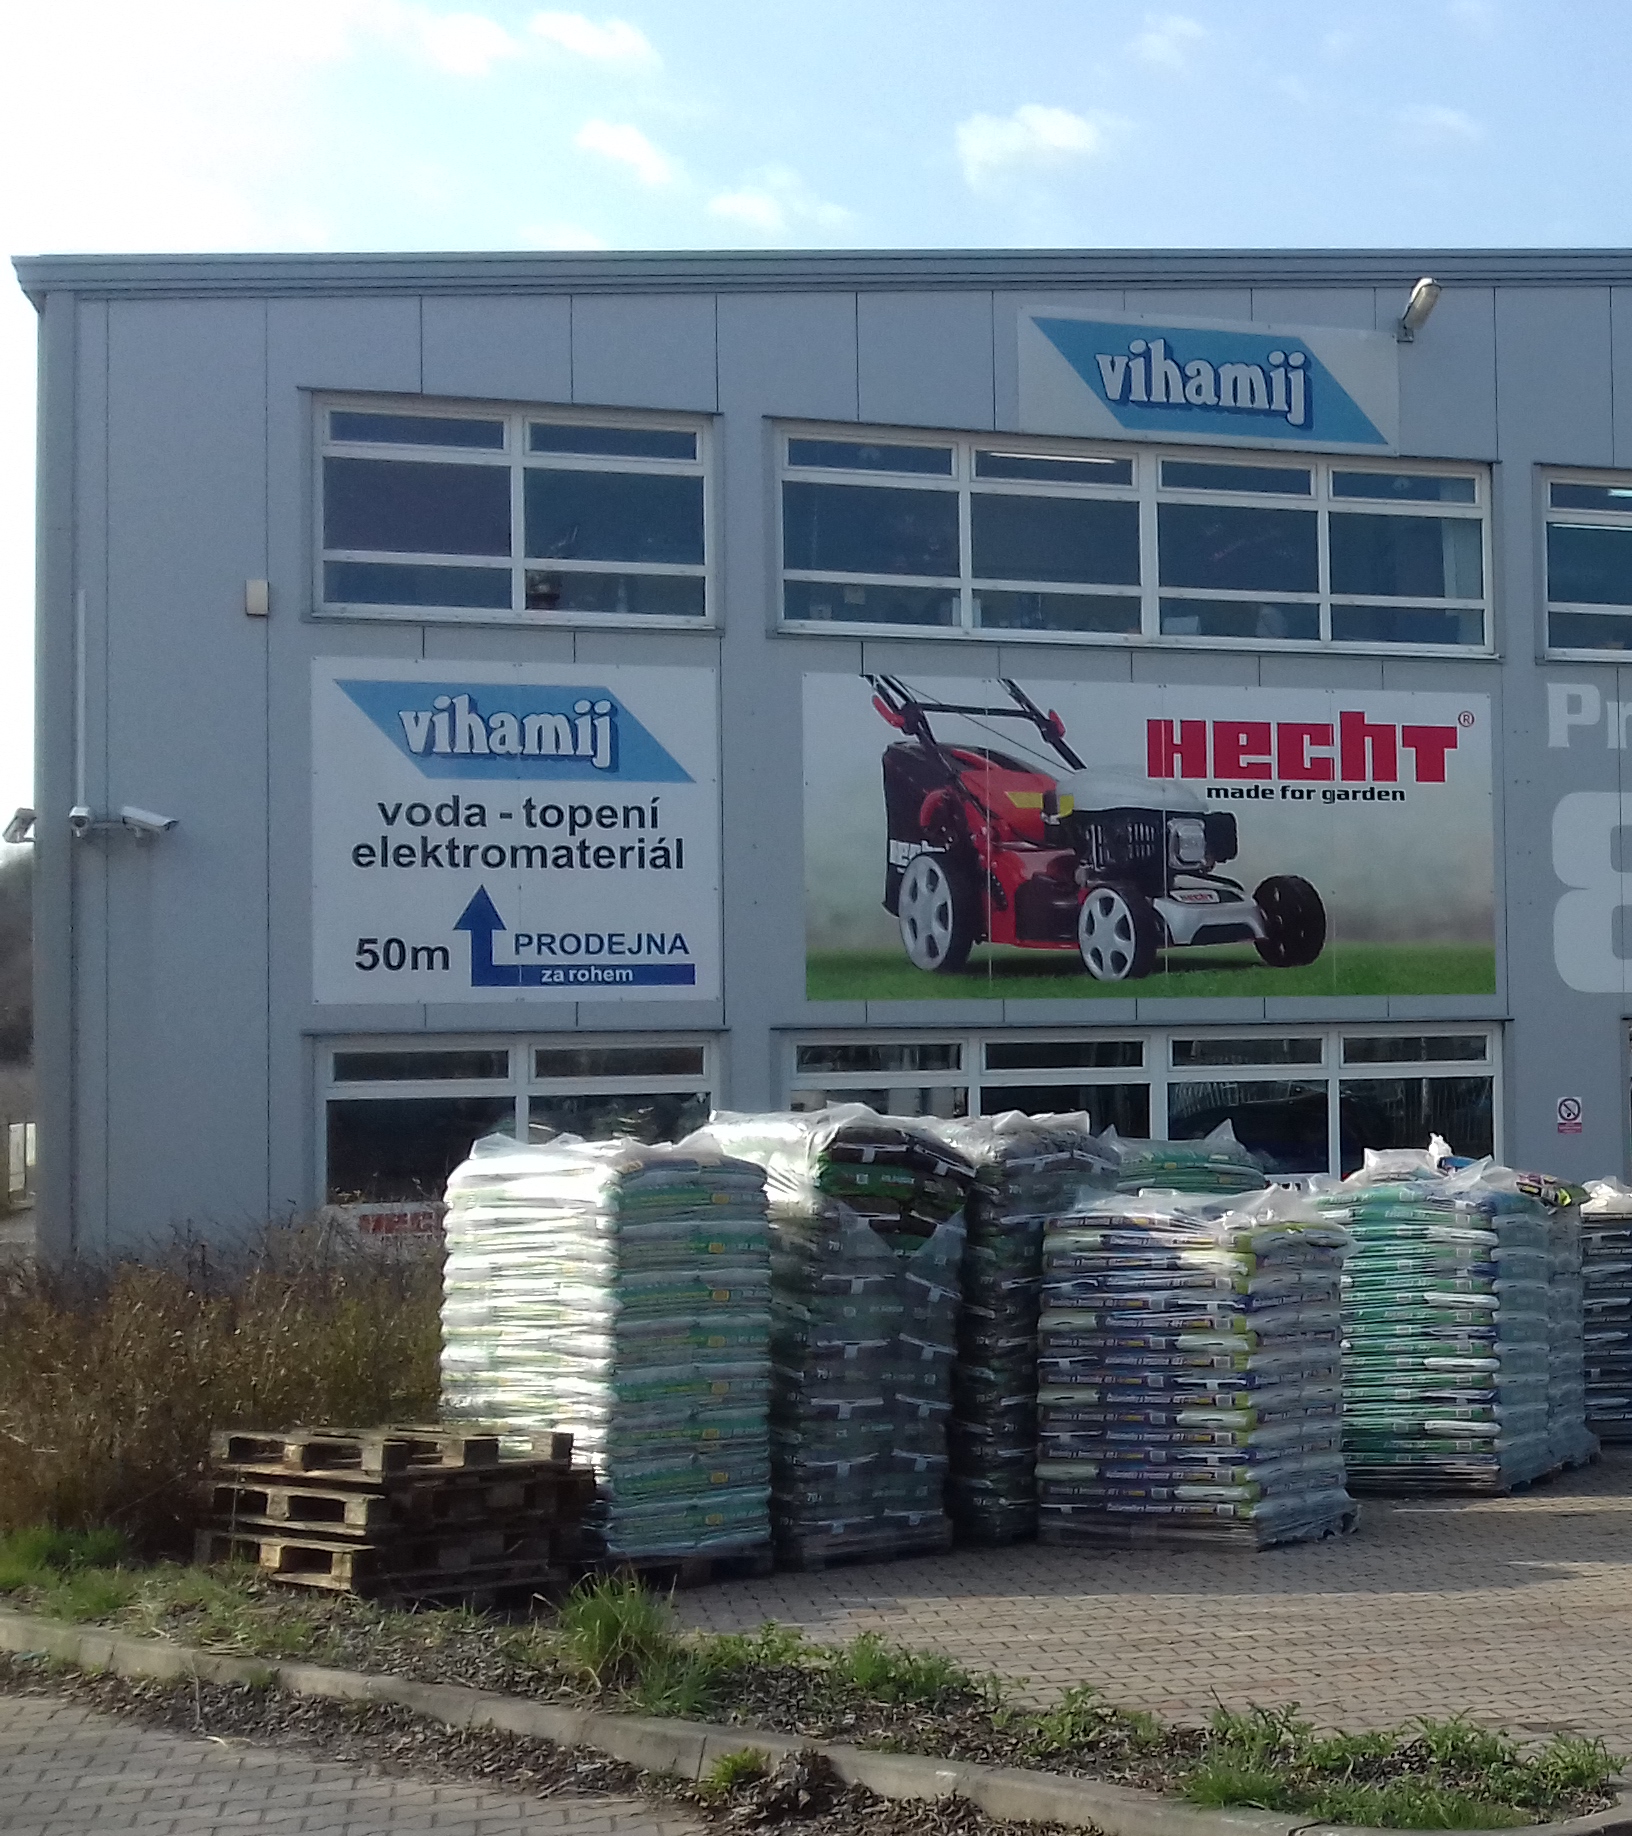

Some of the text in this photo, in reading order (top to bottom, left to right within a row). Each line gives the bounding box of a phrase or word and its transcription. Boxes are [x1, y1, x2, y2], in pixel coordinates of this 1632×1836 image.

[1095, 338, 1309, 428] vihamij
[399, 694, 616, 768] vihamij
[1206, 785, 1406, 804] made for garden
[377, 795, 488, 828] voda
[522, 796, 661, 837] topení
[351, 836, 685, 869] elektromateriál
[354, 932, 691, 971] 50m PRODEJNA
[541, 967, 634, 983] za rohem
